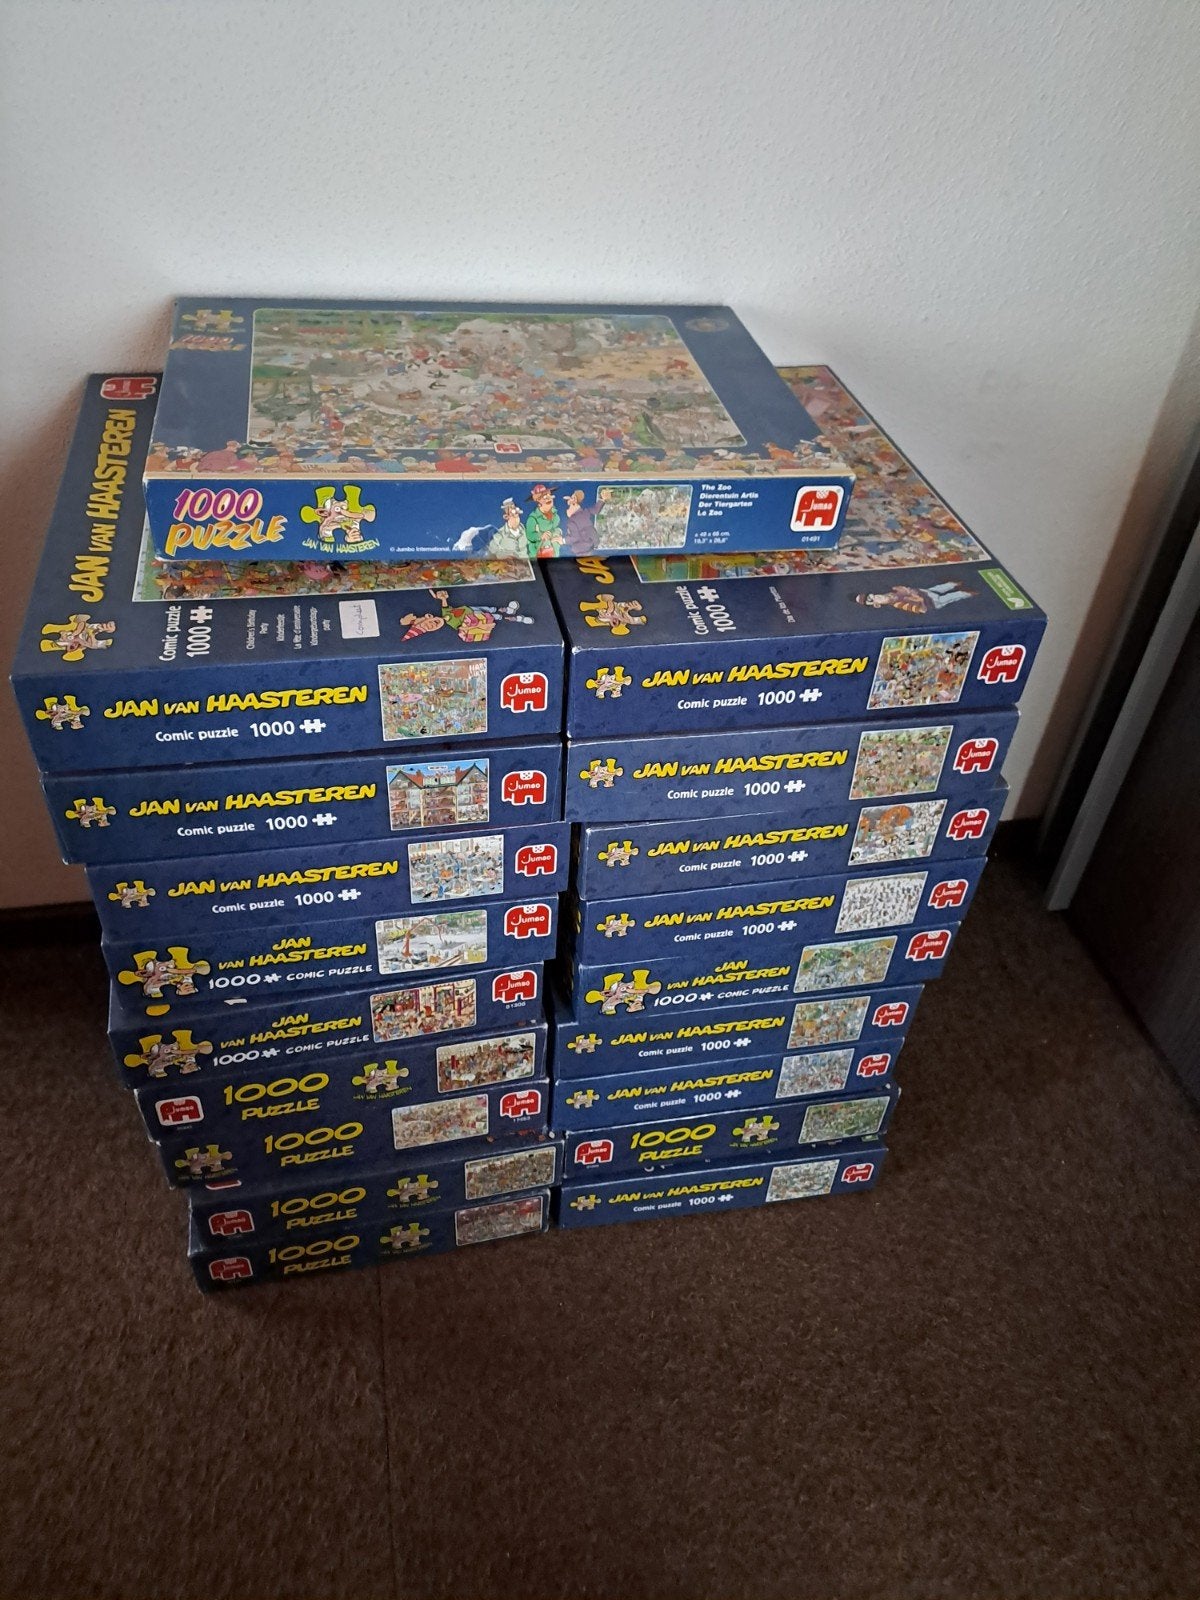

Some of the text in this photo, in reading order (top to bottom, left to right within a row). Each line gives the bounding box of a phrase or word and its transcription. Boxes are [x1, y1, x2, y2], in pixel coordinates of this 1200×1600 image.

[85, 408, 136, 520] HAASTEREN
[173, 488, 263, 521] 1000
[700, 492, 739, 500] Dierentuin
[302, 538, 380, 554] JAN VAN HAASTEREN
[68, 555, 110, 602] JAN
[675, 586, 709, 635] Comic puzzle
[705, 604, 736, 633] 1000
[159, 605, 182, 662] Comic puzzle
[186, 626, 212, 658] 1000
[642, 669, 690, 688] JAN
[727, 656, 869, 683] HAASTEREN
[104, 699, 158, 718] JAN
[206, 685, 368, 713] HAASTEREN
[677, 690, 796, 710] Comic puzzle 1000
[156, 721, 295, 742] Comic puzzle 1000
[632, 761, 679, 779] JAN
[714, 750, 849, 775] HAASTEREN
[129, 799, 180, 817] JAN
[225, 783, 376, 810] HAASTEREN
[667, 781, 781, 800] Comic puzzle 1000
[177, 815, 308, 836] Comic puzzle 1000
[647, 840, 690, 857] JAN
[723, 823, 849, 849] HAASTEREN
[679, 852, 785, 873] Comic puzzle 1000
[168, 880, 215, 897] JAN
[257, 861, 398, 888] HAASTEREN
[212, 891, 334, 914] Comic puzzle 1000
[644, 912, 684, 929] JAN
[716, 895, 835, 920] HAASTEREN
[272, 936, 311, 951] JAN
[674, 922, 775, 943] Comic puzzle 1000
[218, 944, 367, 970] VAN HAASTEREN
[715, 960, 748, 973] JAN
[209, 965, 373, 989] 1000 COMIC PUZZLE
[667, 966, 791, 990] VAN HAASTEREN
[654, 984, 790, 1007] 1000 COMIC PUZZLE
[220, 1016, 362, 1049] VAN HAASTEREN
[272, 1013, 309, 1028] JAN
[610, 1032, 648, 1046] JAN
[676, 1016, 786, 1038] HAASTEREN
[213, 1034, 369, 1067] 1000 COMIC PUZZLE
[638, 1040, 731, 1058] Comic puzzle 1000
[223, 1072, 330, 1105] 1000
[607, 1087, 642, 1101] JAN
[670, 1069, 774, 1092] HAASTEREN
[241, 1098, 321, 1121] PUZZLE
[633, 1092, 722, 1111] Comic puzzle 1000
[264, 1121, 364, 1154] 1000
[630, 1123, 717, 1149] 1000
[280, 1145, 355, 1167] PUZZLE
[638, 1145, 703, 1162] PUZZLE
[270, 1187, 367, 1218] 1000
[608, 1192, 641, 1204] JAN
[667, 1177, 764, 1197] HAASTEREN
[633, 1196, 715, 1212] Comic puzzle 1000
[286, 1208, 358, 1230] PUZZLE
[269, 1235, 360, 1263] 1000
[284, 1254, 352, 1275] PUZZLE
